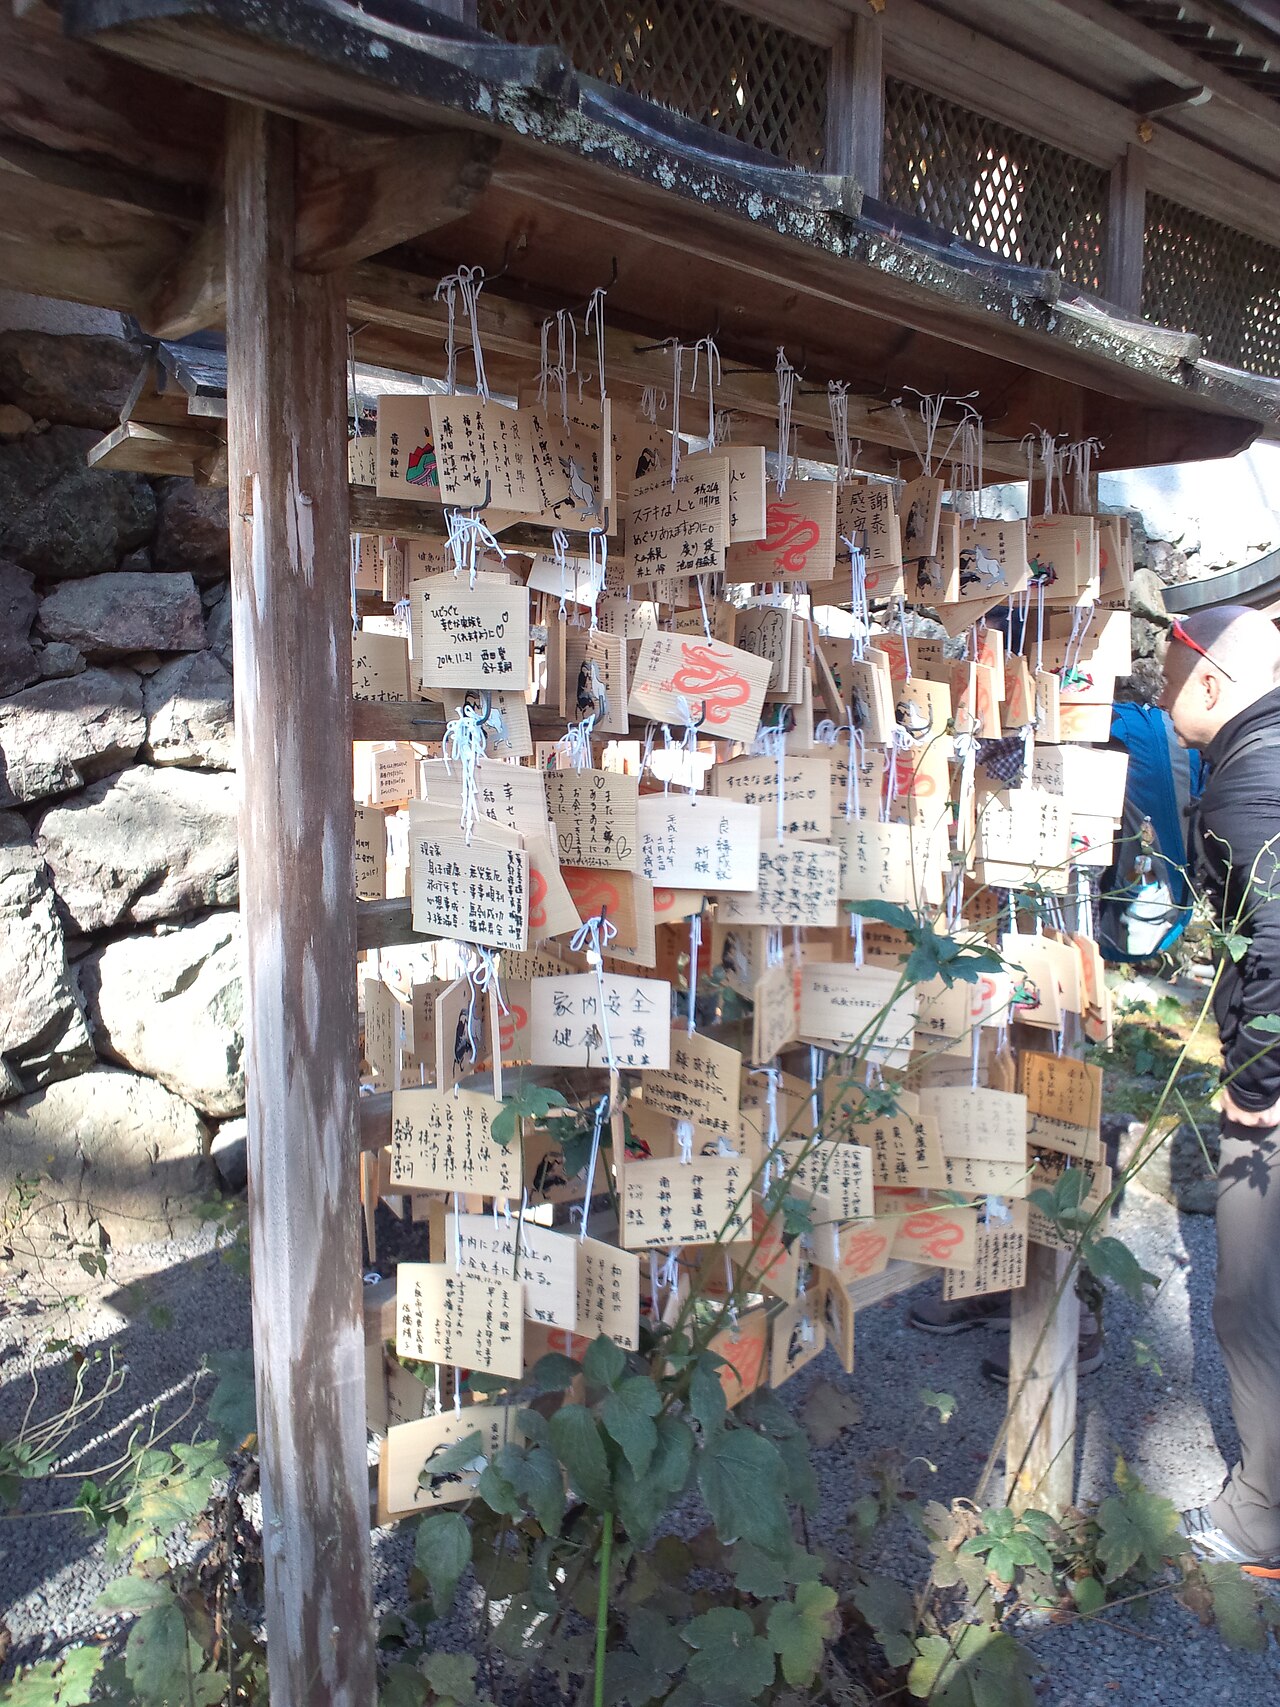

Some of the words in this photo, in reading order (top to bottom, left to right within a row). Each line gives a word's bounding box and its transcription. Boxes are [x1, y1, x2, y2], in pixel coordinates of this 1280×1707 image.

[390, 433, 400, 478] 貴船神社
[632, 499, 696, 524] ステキな人と
[553, 988, 655, 1017] 家内安全
